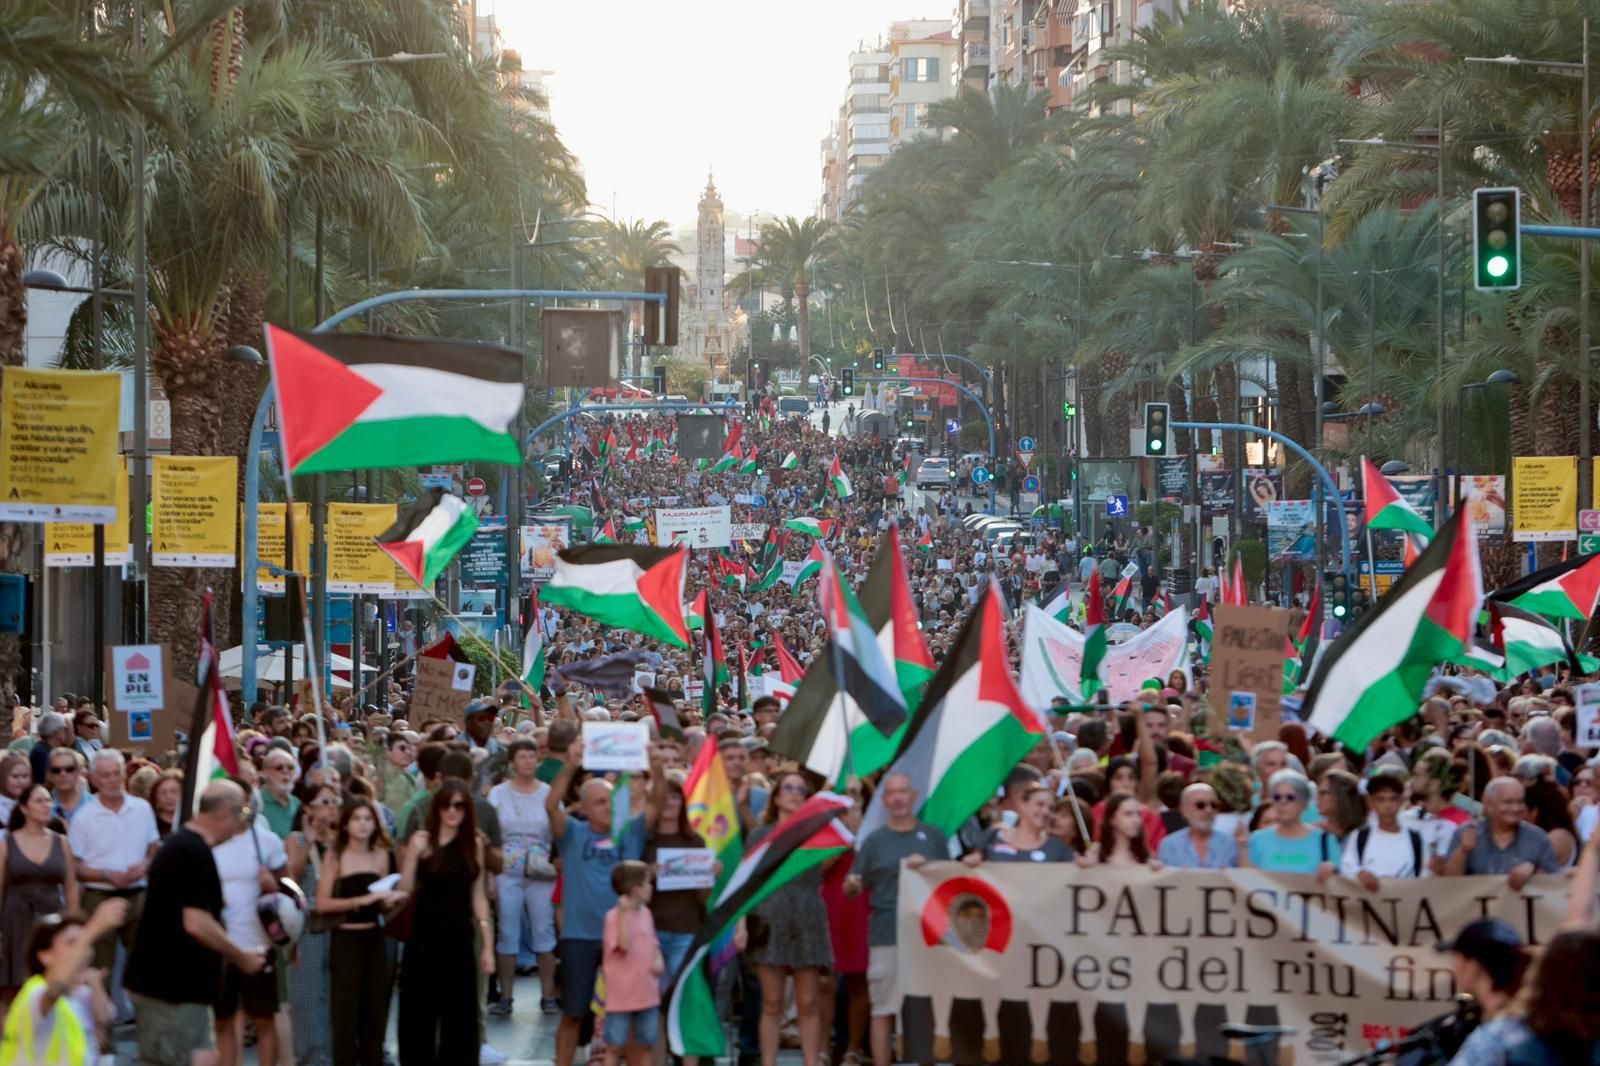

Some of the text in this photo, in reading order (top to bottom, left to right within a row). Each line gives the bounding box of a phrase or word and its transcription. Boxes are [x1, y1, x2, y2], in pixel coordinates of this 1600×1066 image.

[126, 683, 152, 694] PIE
[127, 673, 148, 683] EN
[1065, 883, 1444, 947] PALESTINA
[1025, 943, 1133, 991] Des
[1157, 945, 1248, 993] del
[1272, 951, 1360, 999] riu
